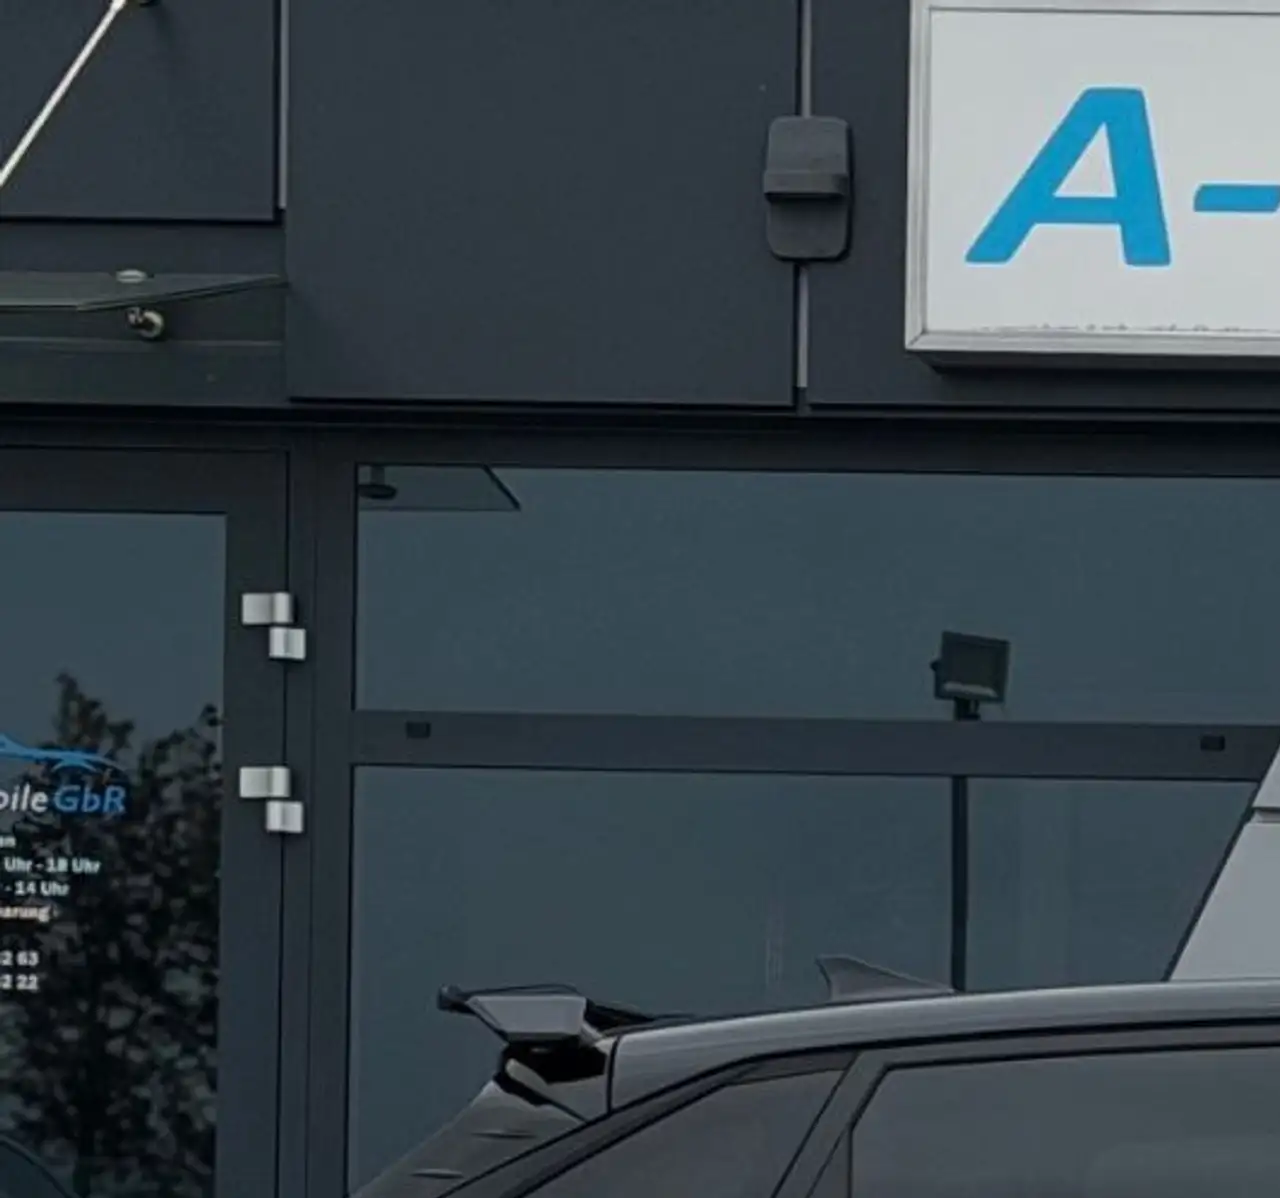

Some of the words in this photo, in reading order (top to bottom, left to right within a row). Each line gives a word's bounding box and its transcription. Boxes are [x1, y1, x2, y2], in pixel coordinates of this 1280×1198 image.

[53, 784, 126, 813] GbR
[4, 857, 33, 873] Uhr
[72, 857, 102, 874] Uhr
[14, 881, 37, 896] 14
[40, 881, 70, 896] Uhr
[16, 974, 39, 991] 22
